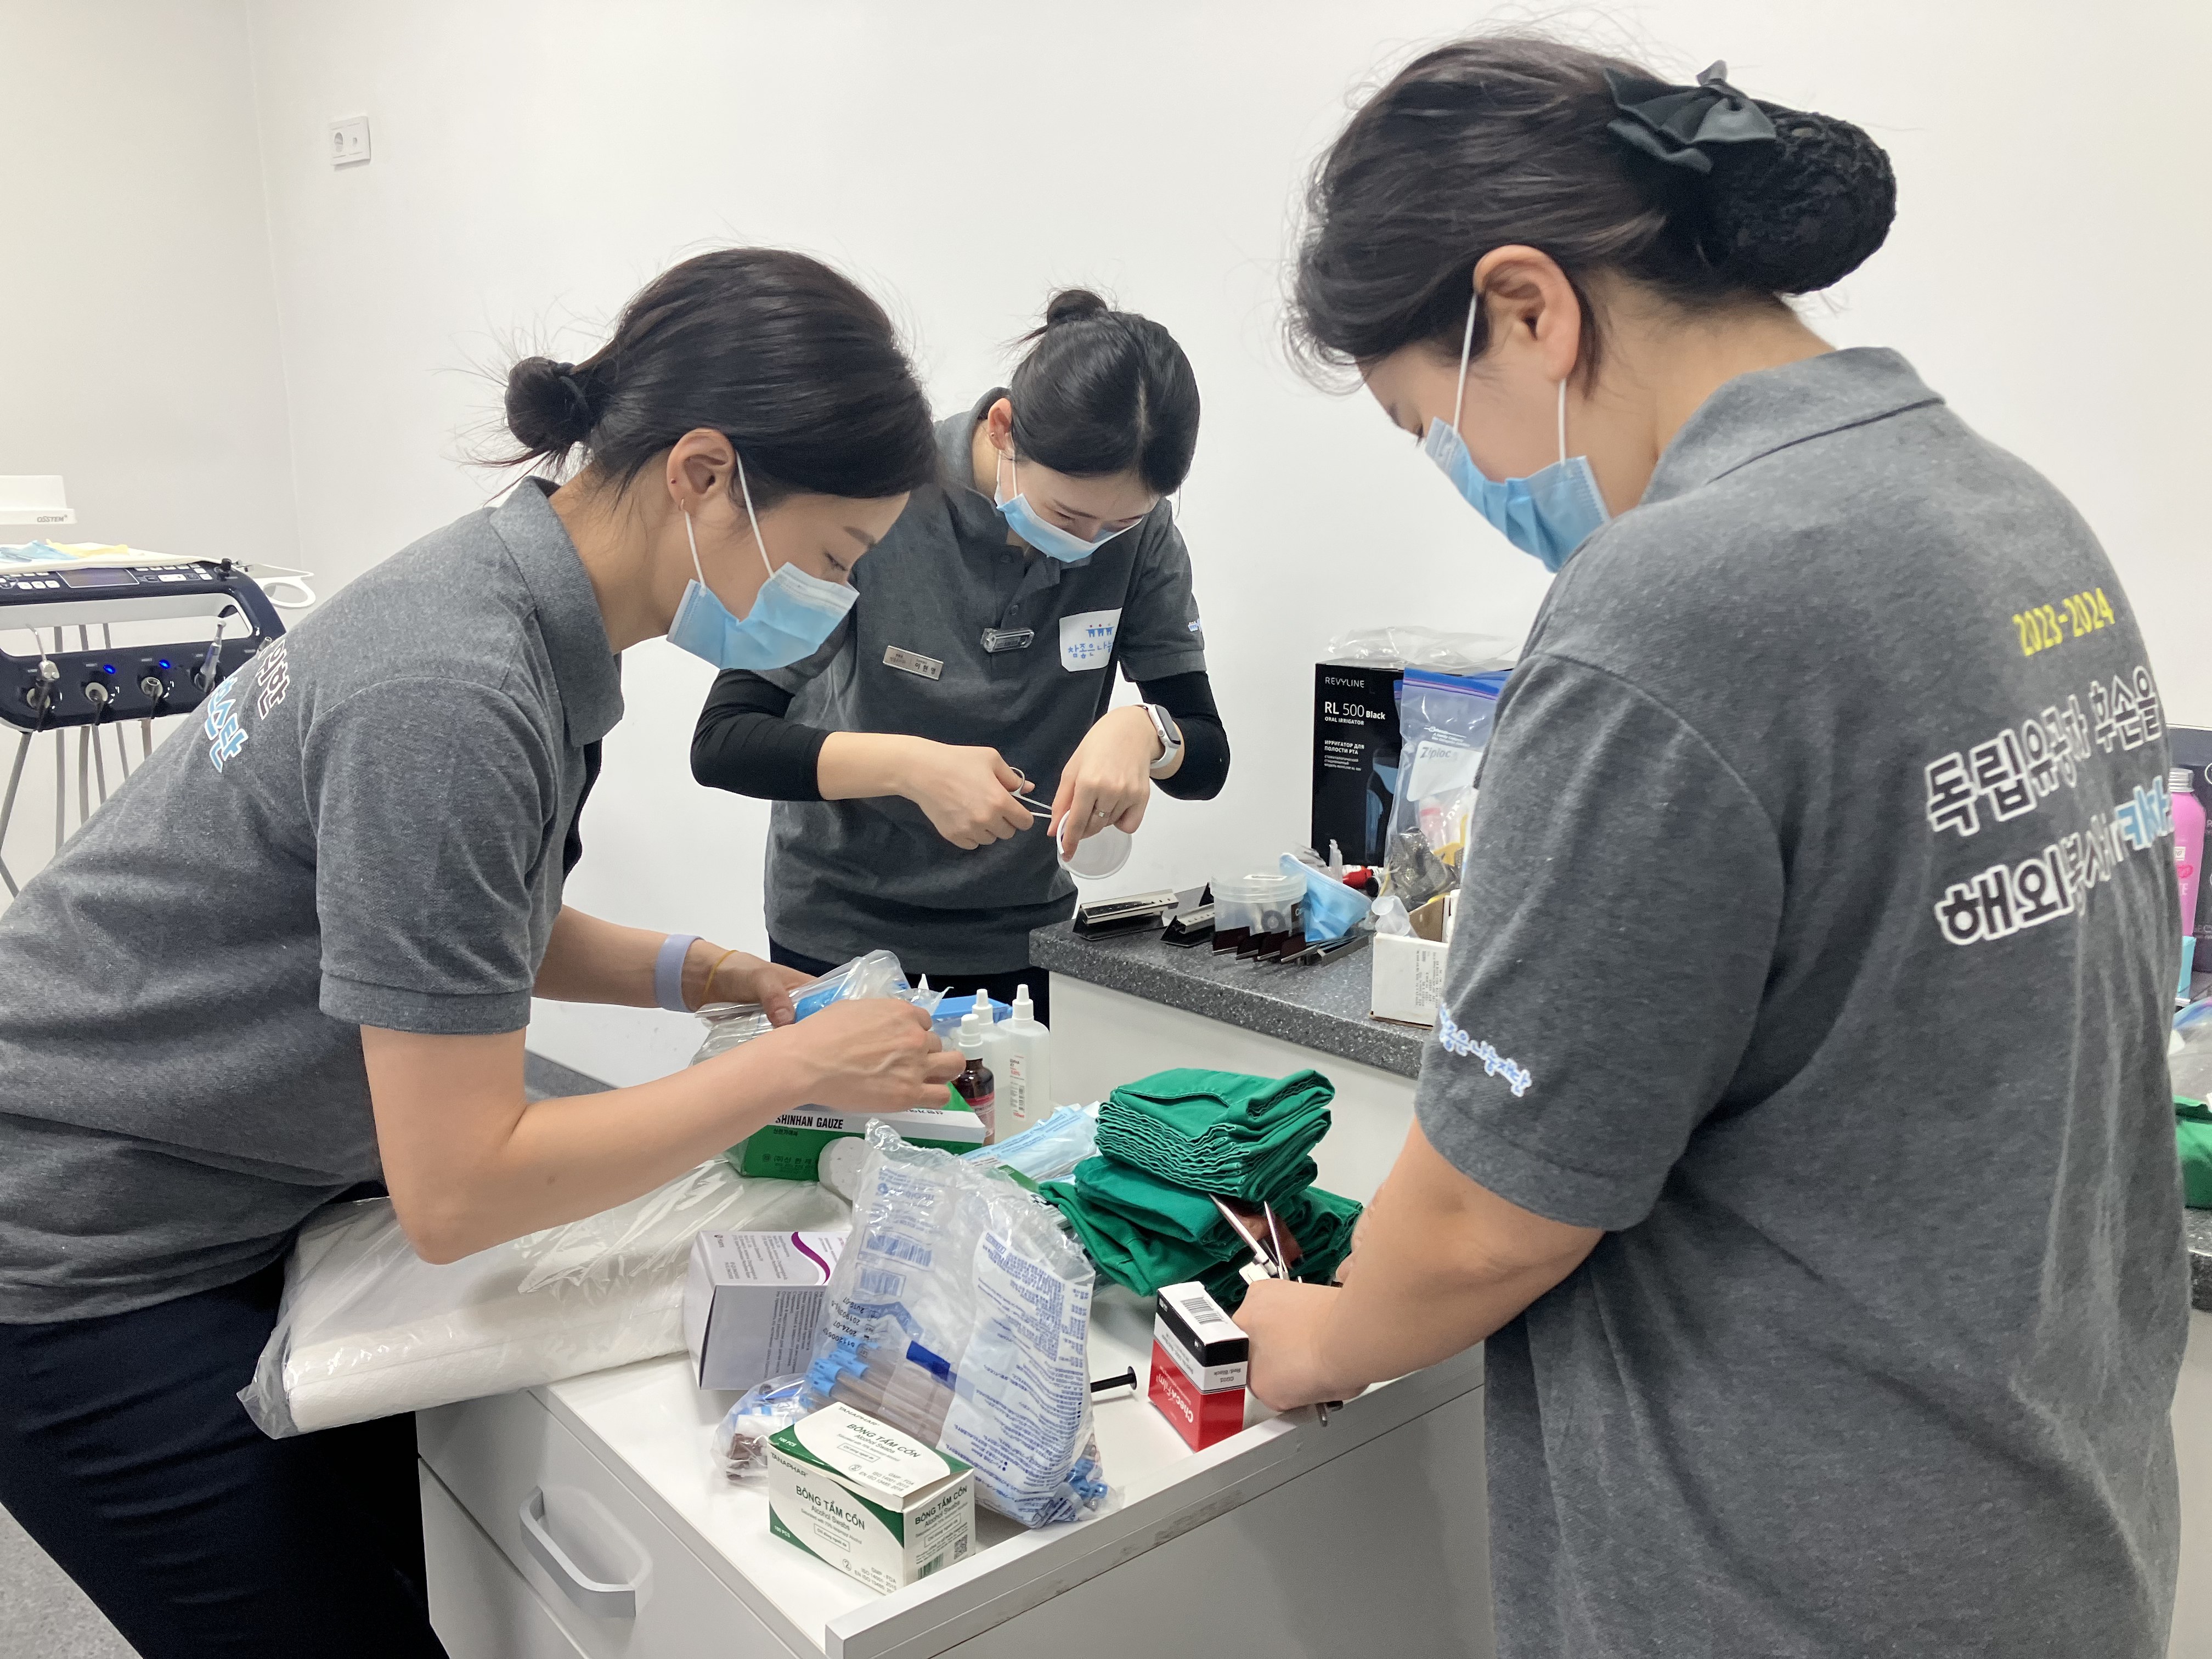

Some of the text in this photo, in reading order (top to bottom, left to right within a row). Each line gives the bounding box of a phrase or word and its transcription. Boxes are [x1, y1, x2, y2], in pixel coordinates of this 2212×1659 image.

[2012, 587, 2116, 657] 2023-2024
[1325, 676, 1364, 689] REVYLINE
[1324, 701, 1386, 720] RL 500 Black
[2088, 665, 2162, 753] 후손을
[1420, 747, 1452, 759] Ziploc
[775, 1114, 844, 1130] SHINHAN GAUZE
[833, 1321, 857, 1336] 2024-07
[839, 1407, 878, 1425] TANAPHAR
[847, 1424, 876, 1437] BÔNG
[854, 1435, 895, 1454] Alcohol Swabs
[771, 1452, 807, 1478] TANAPHAR
[796, 1485, 821, 1506] BÔNG
[811, 1505, 850, 1531] Alcohol Swabs
[915, 1506, 936, 1525] BÔNG
[924, 1512, 943, 1528] Alcohol
[886, 1575, 896, 1584] FDA
